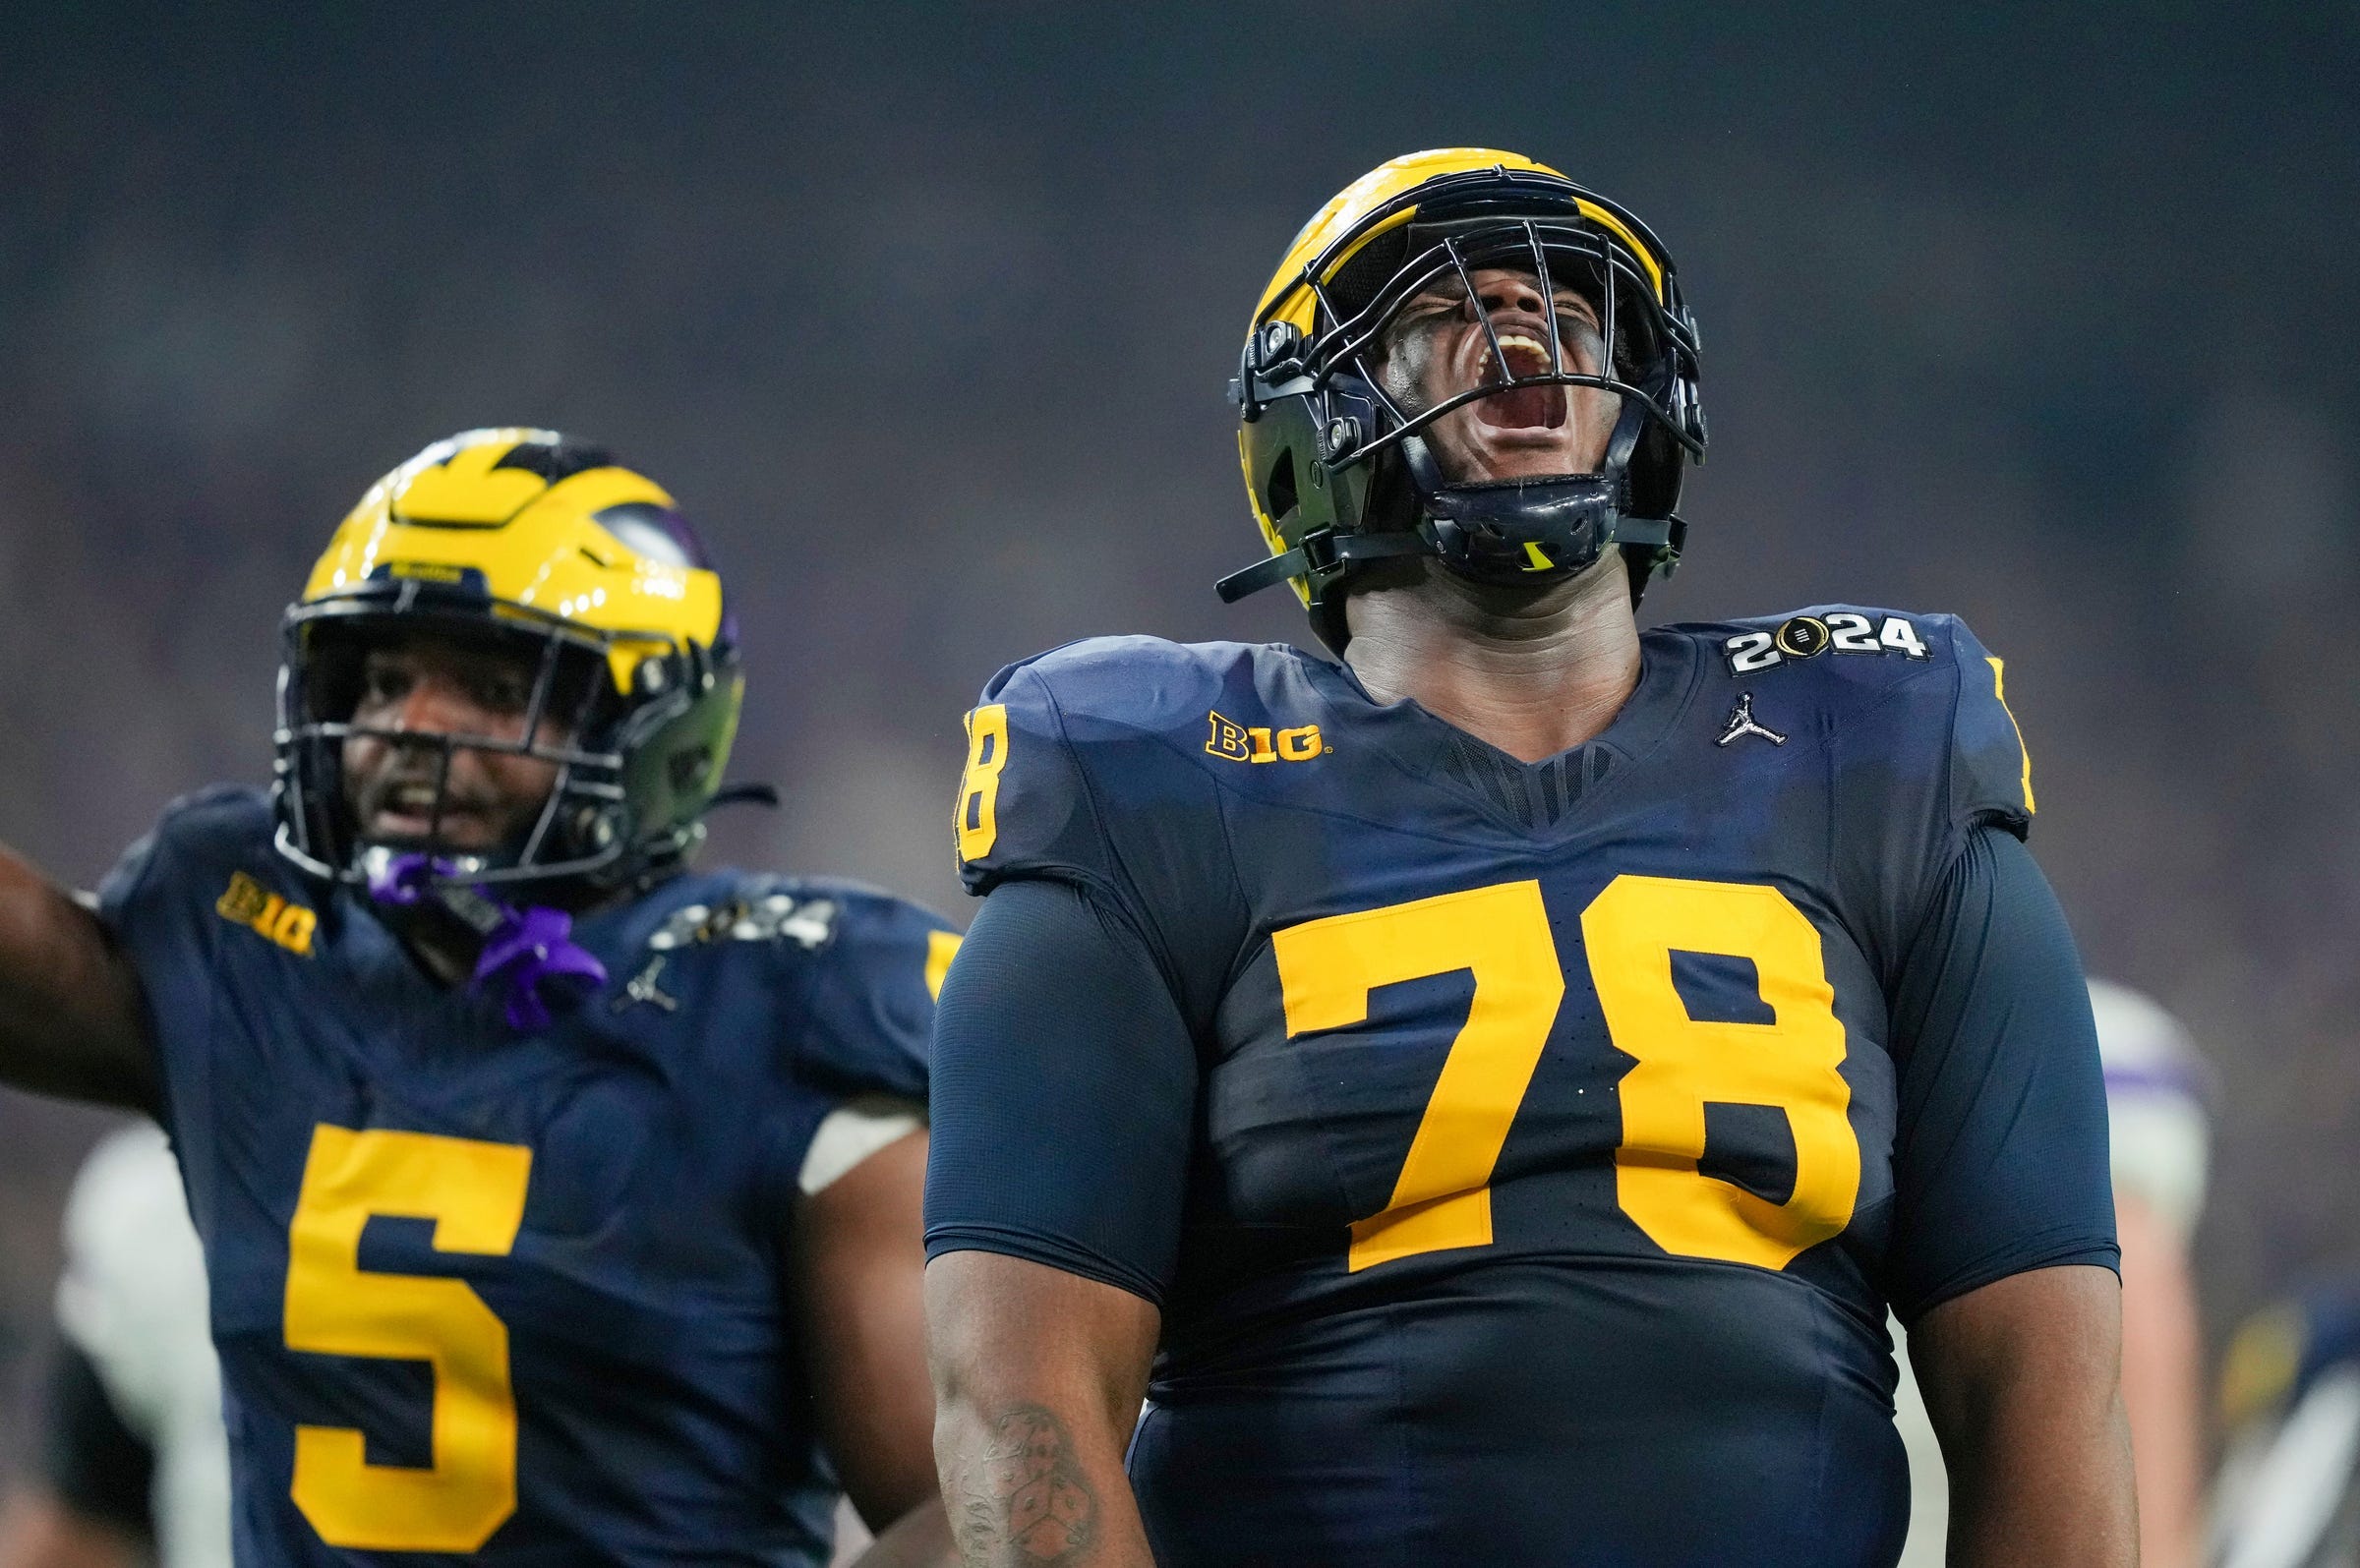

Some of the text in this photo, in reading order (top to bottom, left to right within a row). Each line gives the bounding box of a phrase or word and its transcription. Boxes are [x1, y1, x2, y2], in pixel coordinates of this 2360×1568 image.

[953, 704, 1008, 873] 8
[1206, 710, 1323, 764] BIG
[1271, 874, 1861, 1272] 78
[283, 1122, 533, 1553] 5
